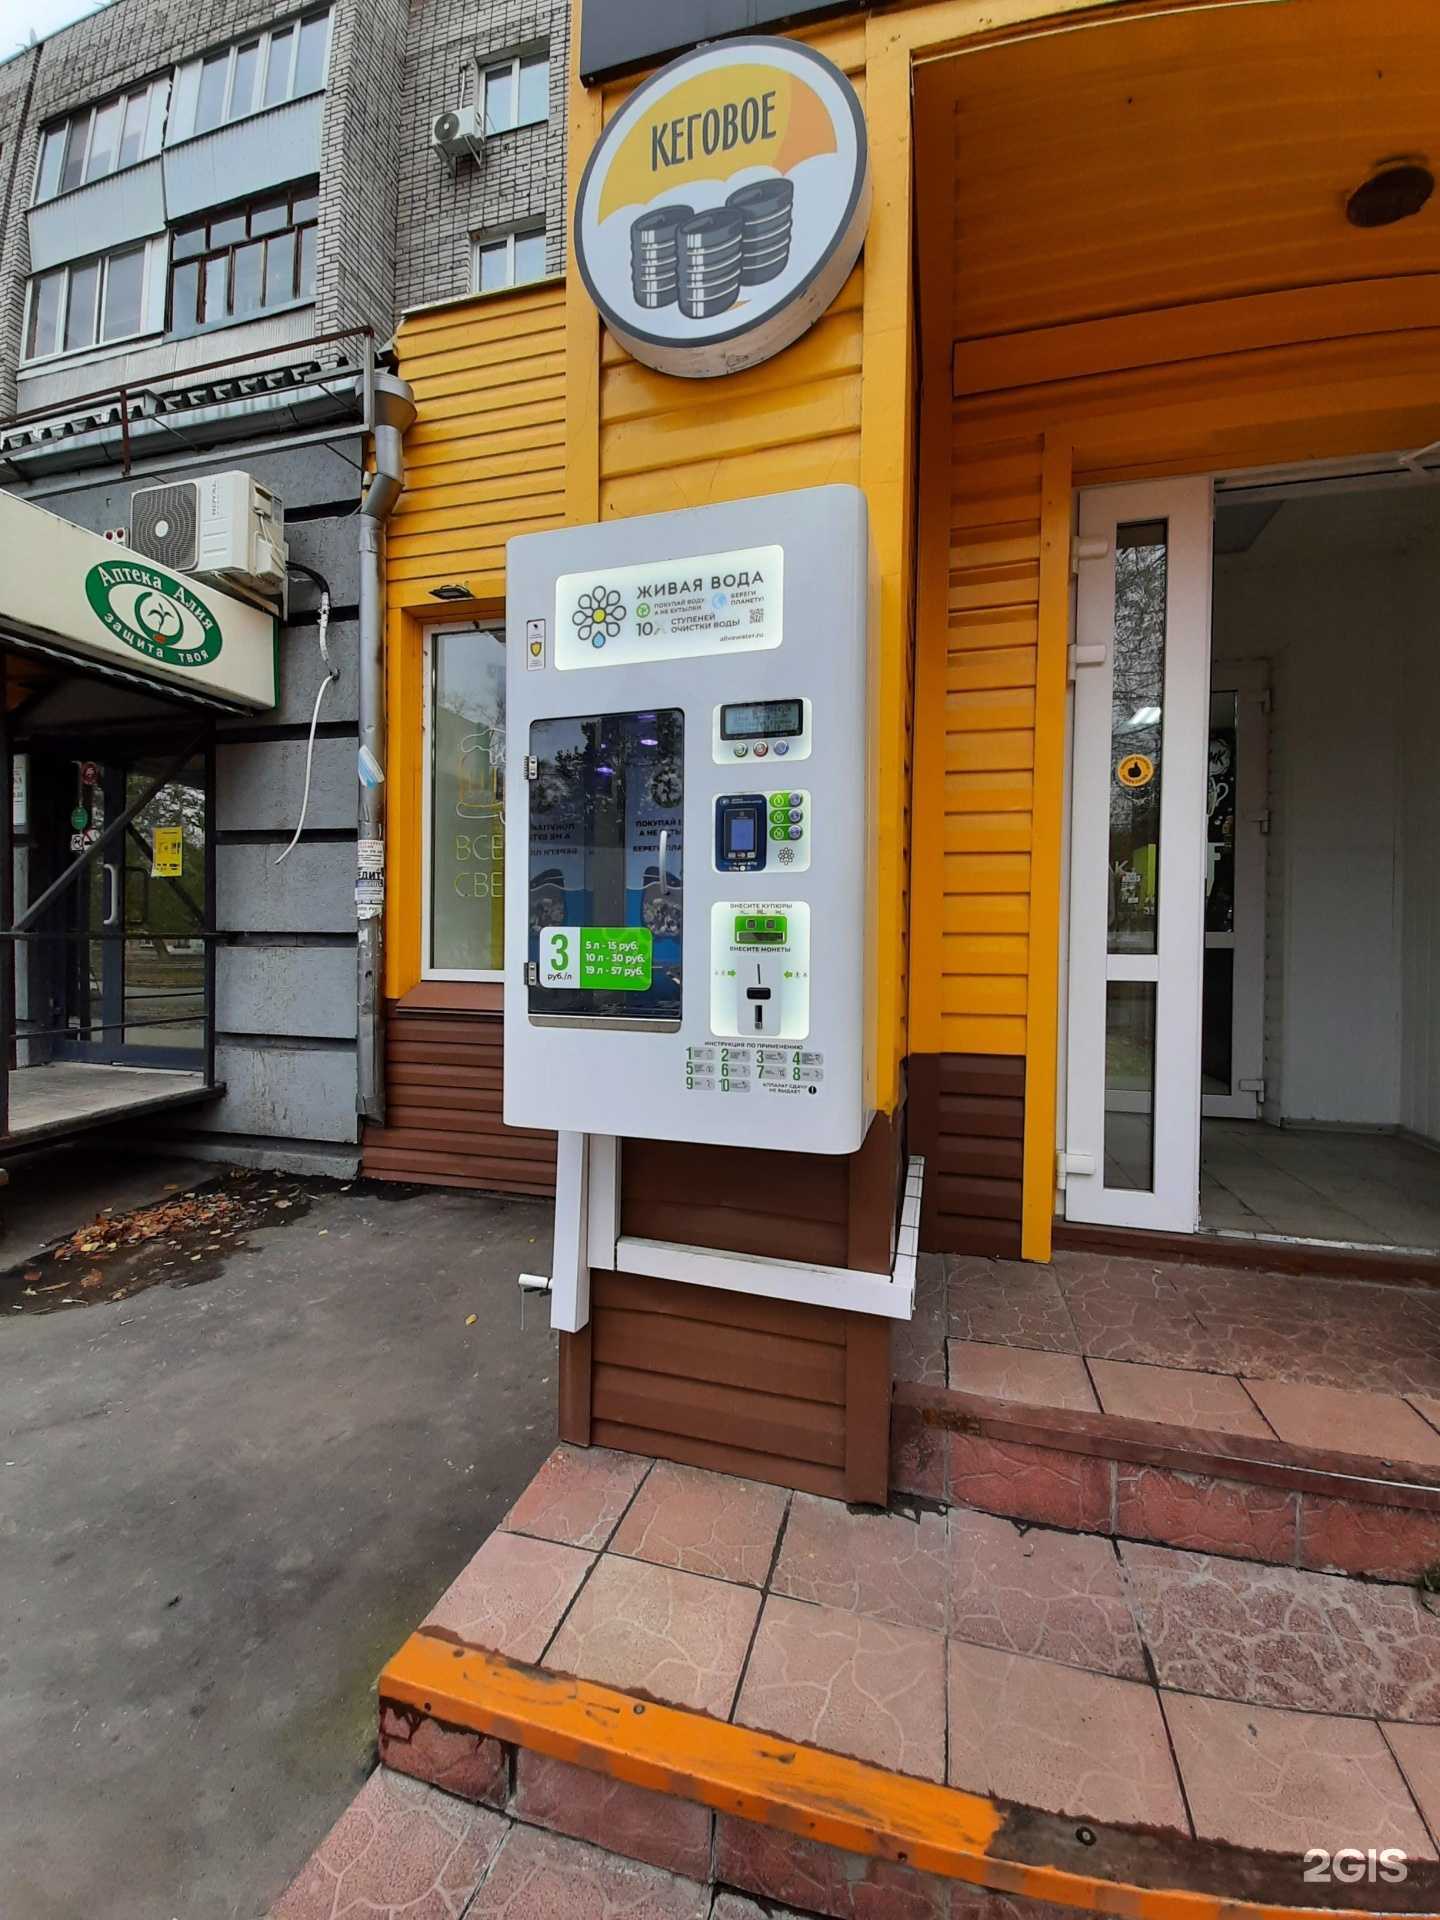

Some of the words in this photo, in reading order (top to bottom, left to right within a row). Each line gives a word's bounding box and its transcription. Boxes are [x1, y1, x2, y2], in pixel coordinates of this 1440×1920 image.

[651, 91, 777, 171] КЕГОВОЕ
[636, 578, 703, 599] ЖИВАЯ
[711, 571, 764, 590] ВОДА
[98, 566, 163, 590] Аптека
[173, 586, 214, 630] Алия
[654, 599, 686, 609] ПОКУПАЙ
[671, 613, 716, 625] СТУПЕНЕЙ
[671, 623, 711, 633] ОЧИСТКИ
[713, 619, 740, 628] ВОДЫ
[636, 622, 653, 636] 10
[550, 933, 569, 971] 3
[585, 941, 592, 950] 5
[607, 941, 617, 950] 15
[619, 941, 639, 953] руб.
[585, 953, 595, 962] 10
[611, 953, 624, 962] 30
[625, 953, 645, 966] руб.
[585, 966, 594, 975] 19
[611, 966, 622, 975] 57
[624, 966, 644, 977] руб.
[686, 1047, 692, 1060] 1
[721, 1048, 729, 1062] 2
[756, 1050, 764, 1064] 3
[792, 1051, 801, 1065] 4
[686, 1062, 693, 1075] 5
[721, 1063, 729, 1077] 6
[756, 1065, 765, 1079] 7
[792, 1067, 801, 1081] 8
[686, 1077, 693, 1090] 9
[719, 1078, 730, 1092] 10
